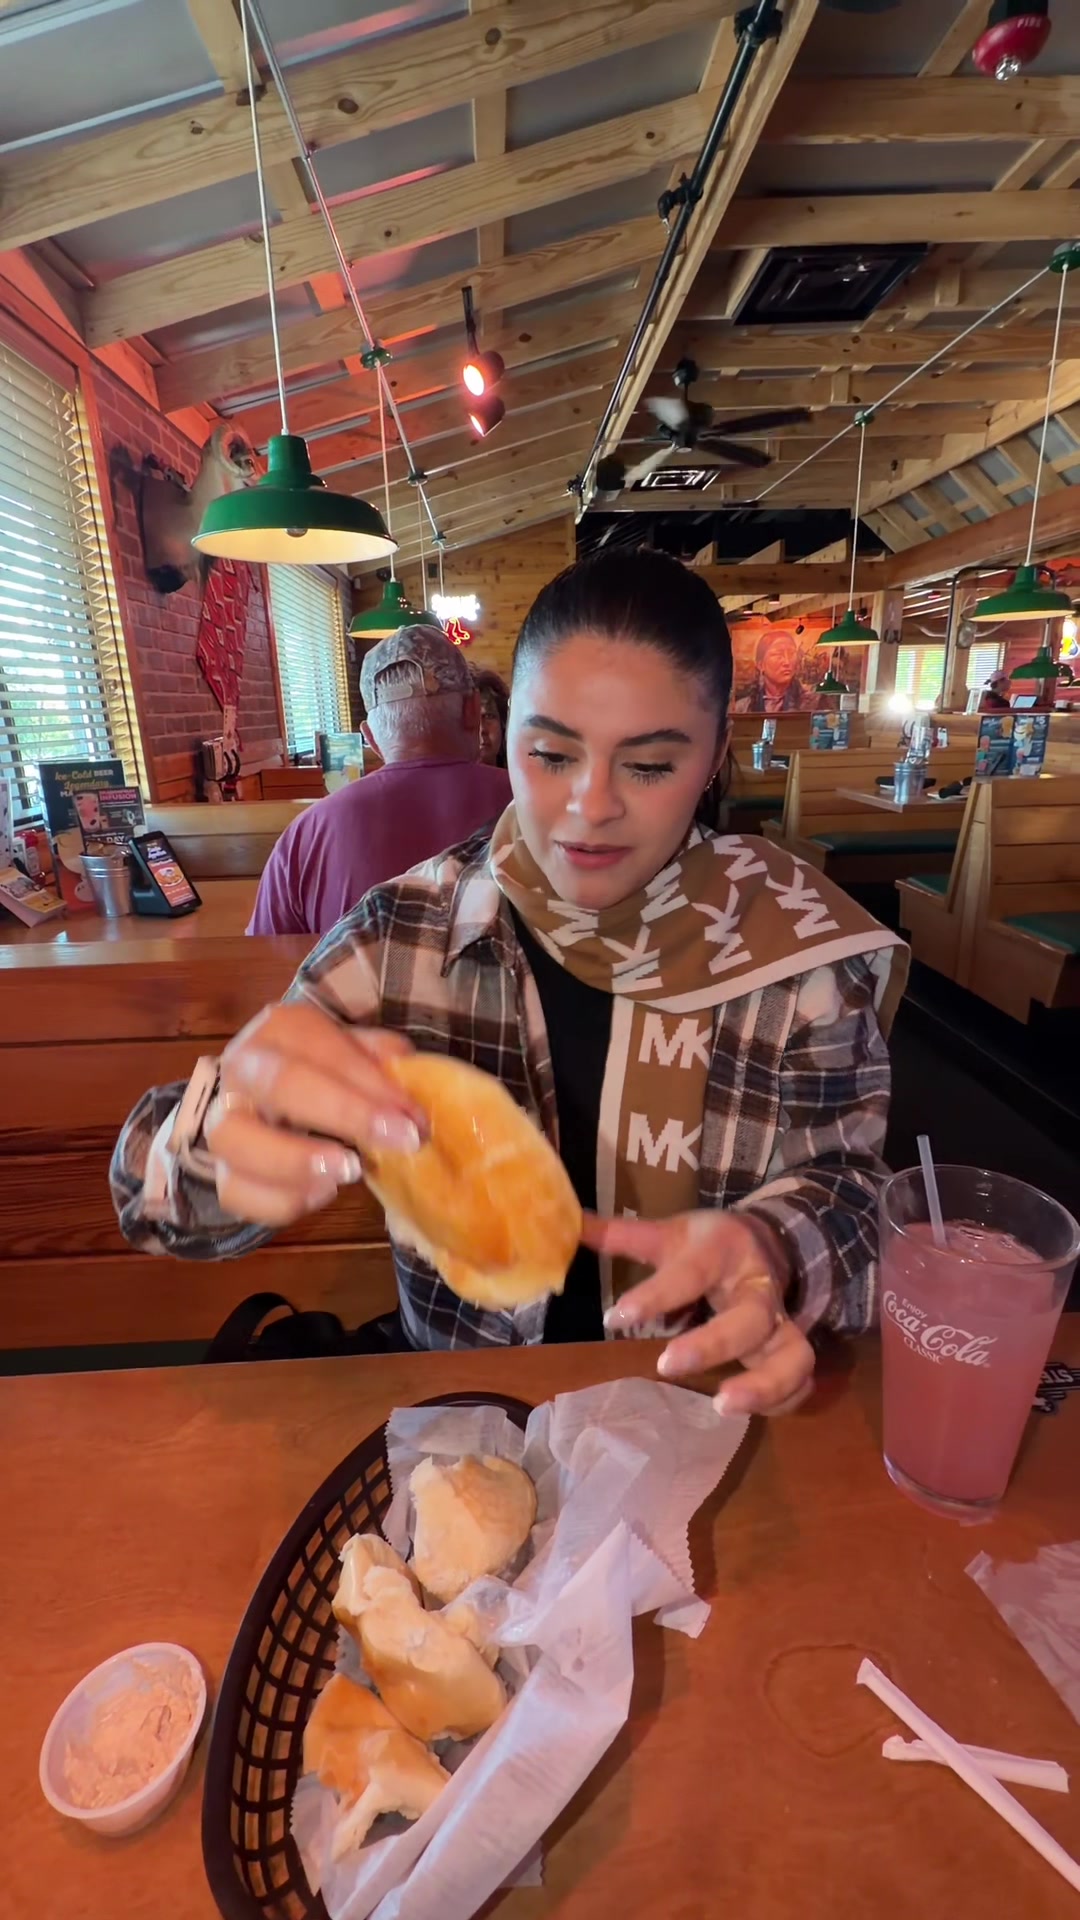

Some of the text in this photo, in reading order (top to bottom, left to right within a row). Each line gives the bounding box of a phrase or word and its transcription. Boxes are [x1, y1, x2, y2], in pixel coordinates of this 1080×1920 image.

[93, 769, 114, 777] BEER
[638, 1011, 713, 1070] MK
[626, 1111, 703, 1173] MK
[901, 1298, 928, 1319] Enjoy
[883, 1290, 999, 1366] Coca-Cola
[903, 1336, 943, 1365] CLASSIC
[1039, 1369, 1074, 1384] STE
